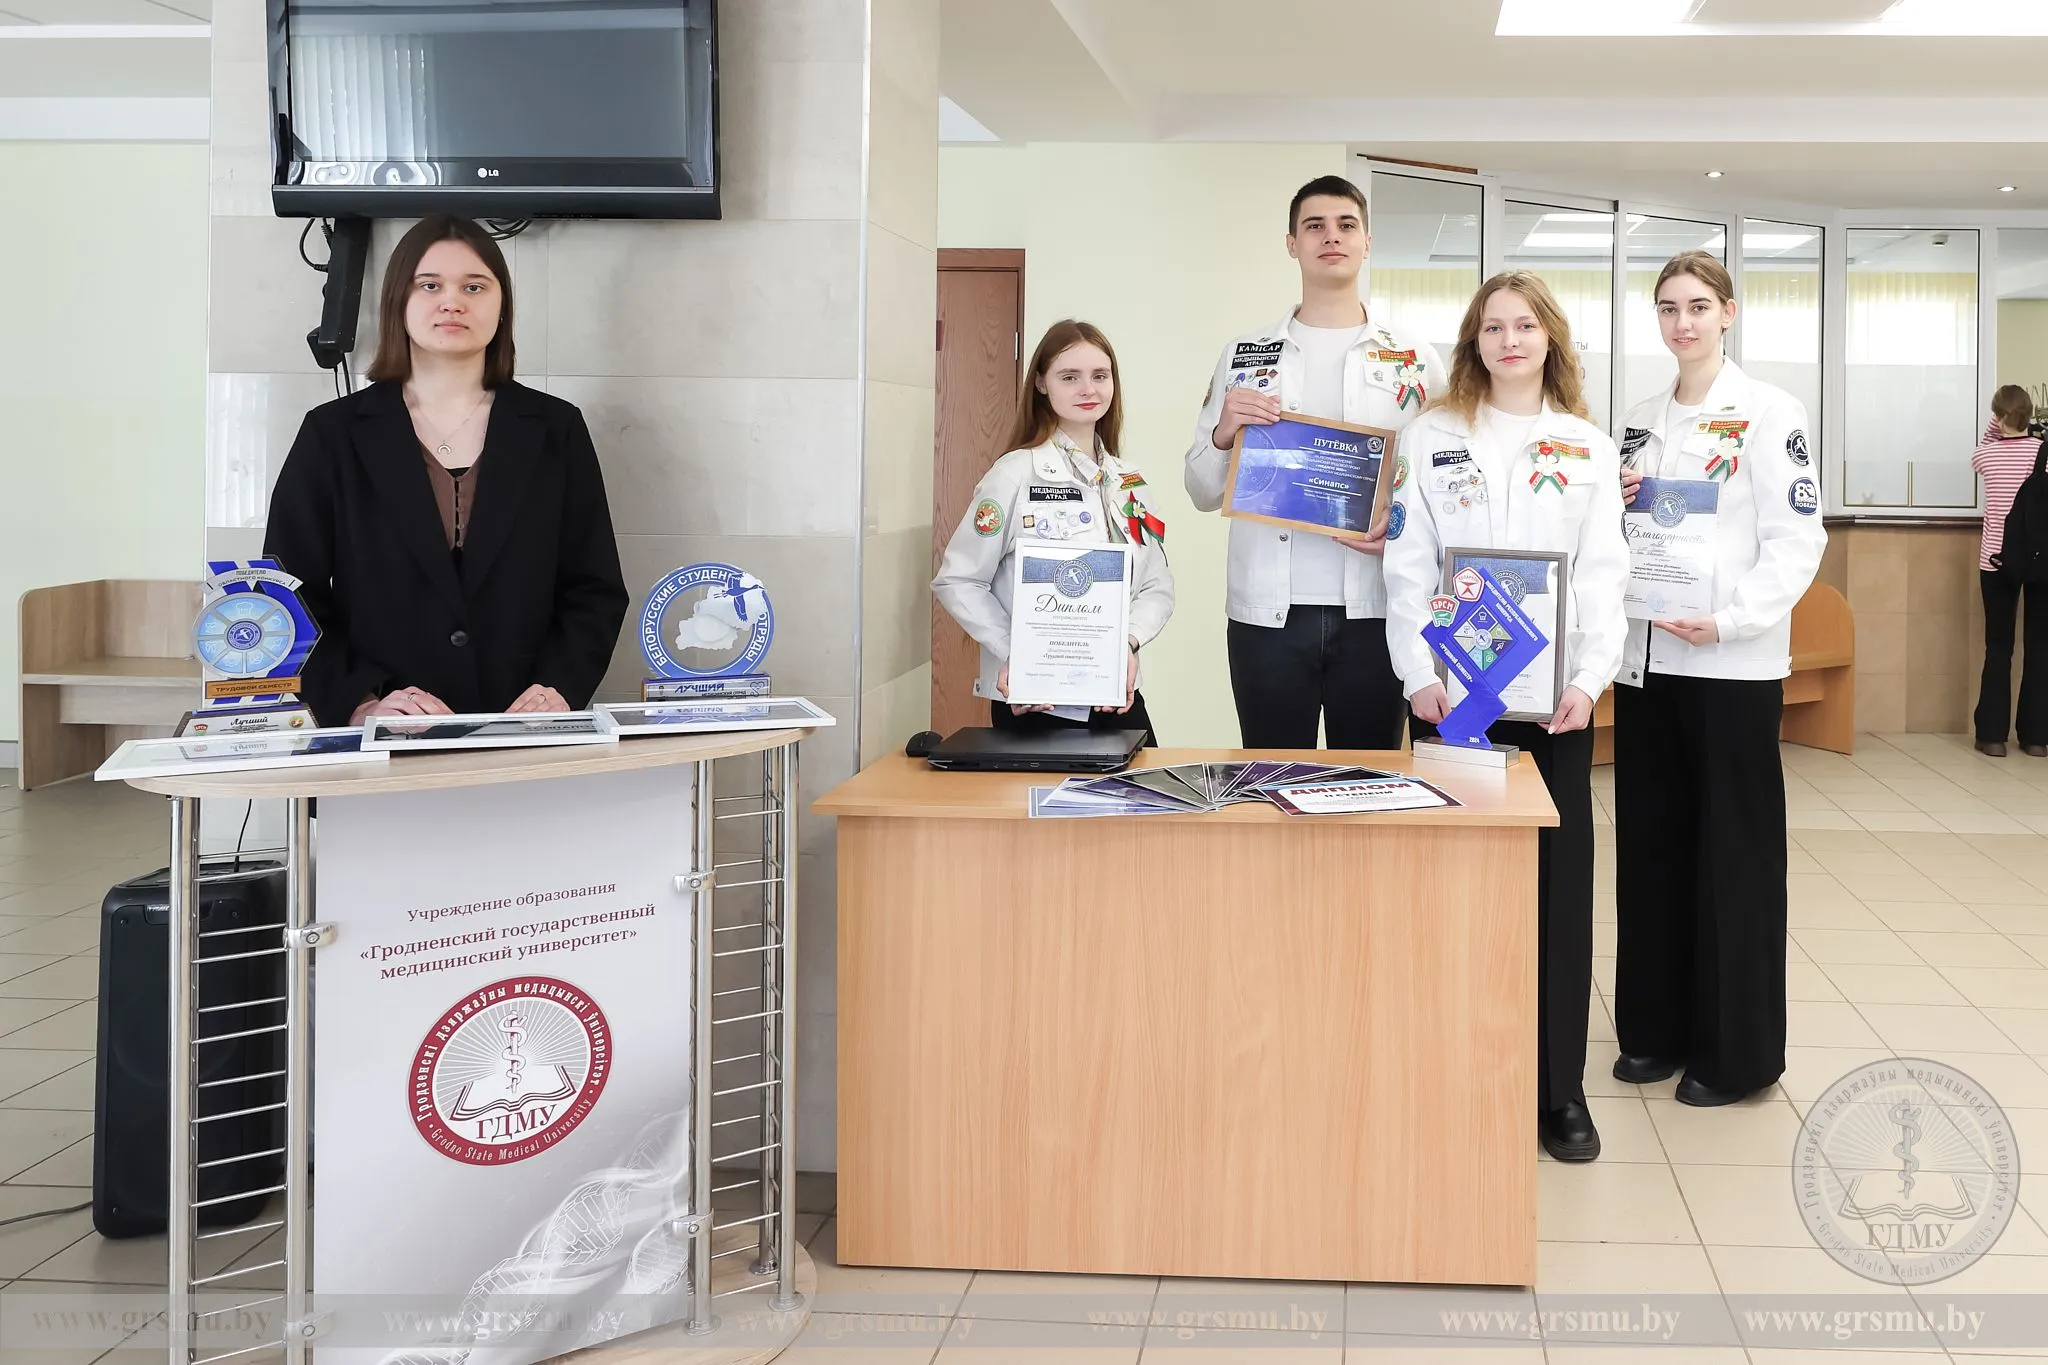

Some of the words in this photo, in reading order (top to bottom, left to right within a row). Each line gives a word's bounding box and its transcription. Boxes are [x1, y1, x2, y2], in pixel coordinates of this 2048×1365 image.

[1238, 343, 1281, 353] КАМІСАР
[1313, 437, 1359, 453] ПУТЁВКА
[1031, 487, 1080, 495] МЕДЫЦЫНСКІ
[1308, 477, 1349, 491] «Синапс»
[1034, 593, 1103, 614] Диплом
[1432, 600, 1454, 611] БРСМ
[645, 582, 678, 667] БЕЛОРУССКИЕ
[215, 684, 258, 693] ТРУДОВОЙ
[258, 682, 292, 690] СЕМЕСТР
[230, 716, 268, 726] Лучший
[1290, 783, 1412, 795] ДИПЛОМ
[407, 898, 512, 922] Учреждение
[516, 883, 616, 907] образования
[359, 927, 497, 961] «Гродненский
[501, 904, 656, 939] государственный
[380, 946, 513, 980] медицинский
[517, 929, 637, 961] университет»
[416, 1044, 438, 1122] Гродзенскі
[435, 986, 506, 1041] дзяржаўны
[514, 981, 592, 1013] медыцынскі
[582, 1010, 609, 1086] ўніверсітэт
[431, 1127, 462, 1155] Grodno
[465, 1146, 493, 1161] State
[498, 1139, 540, 1160] Medical
[542, 1096, 593, 1144] University
[475, 1103, 558, 1143] ГДМУ
